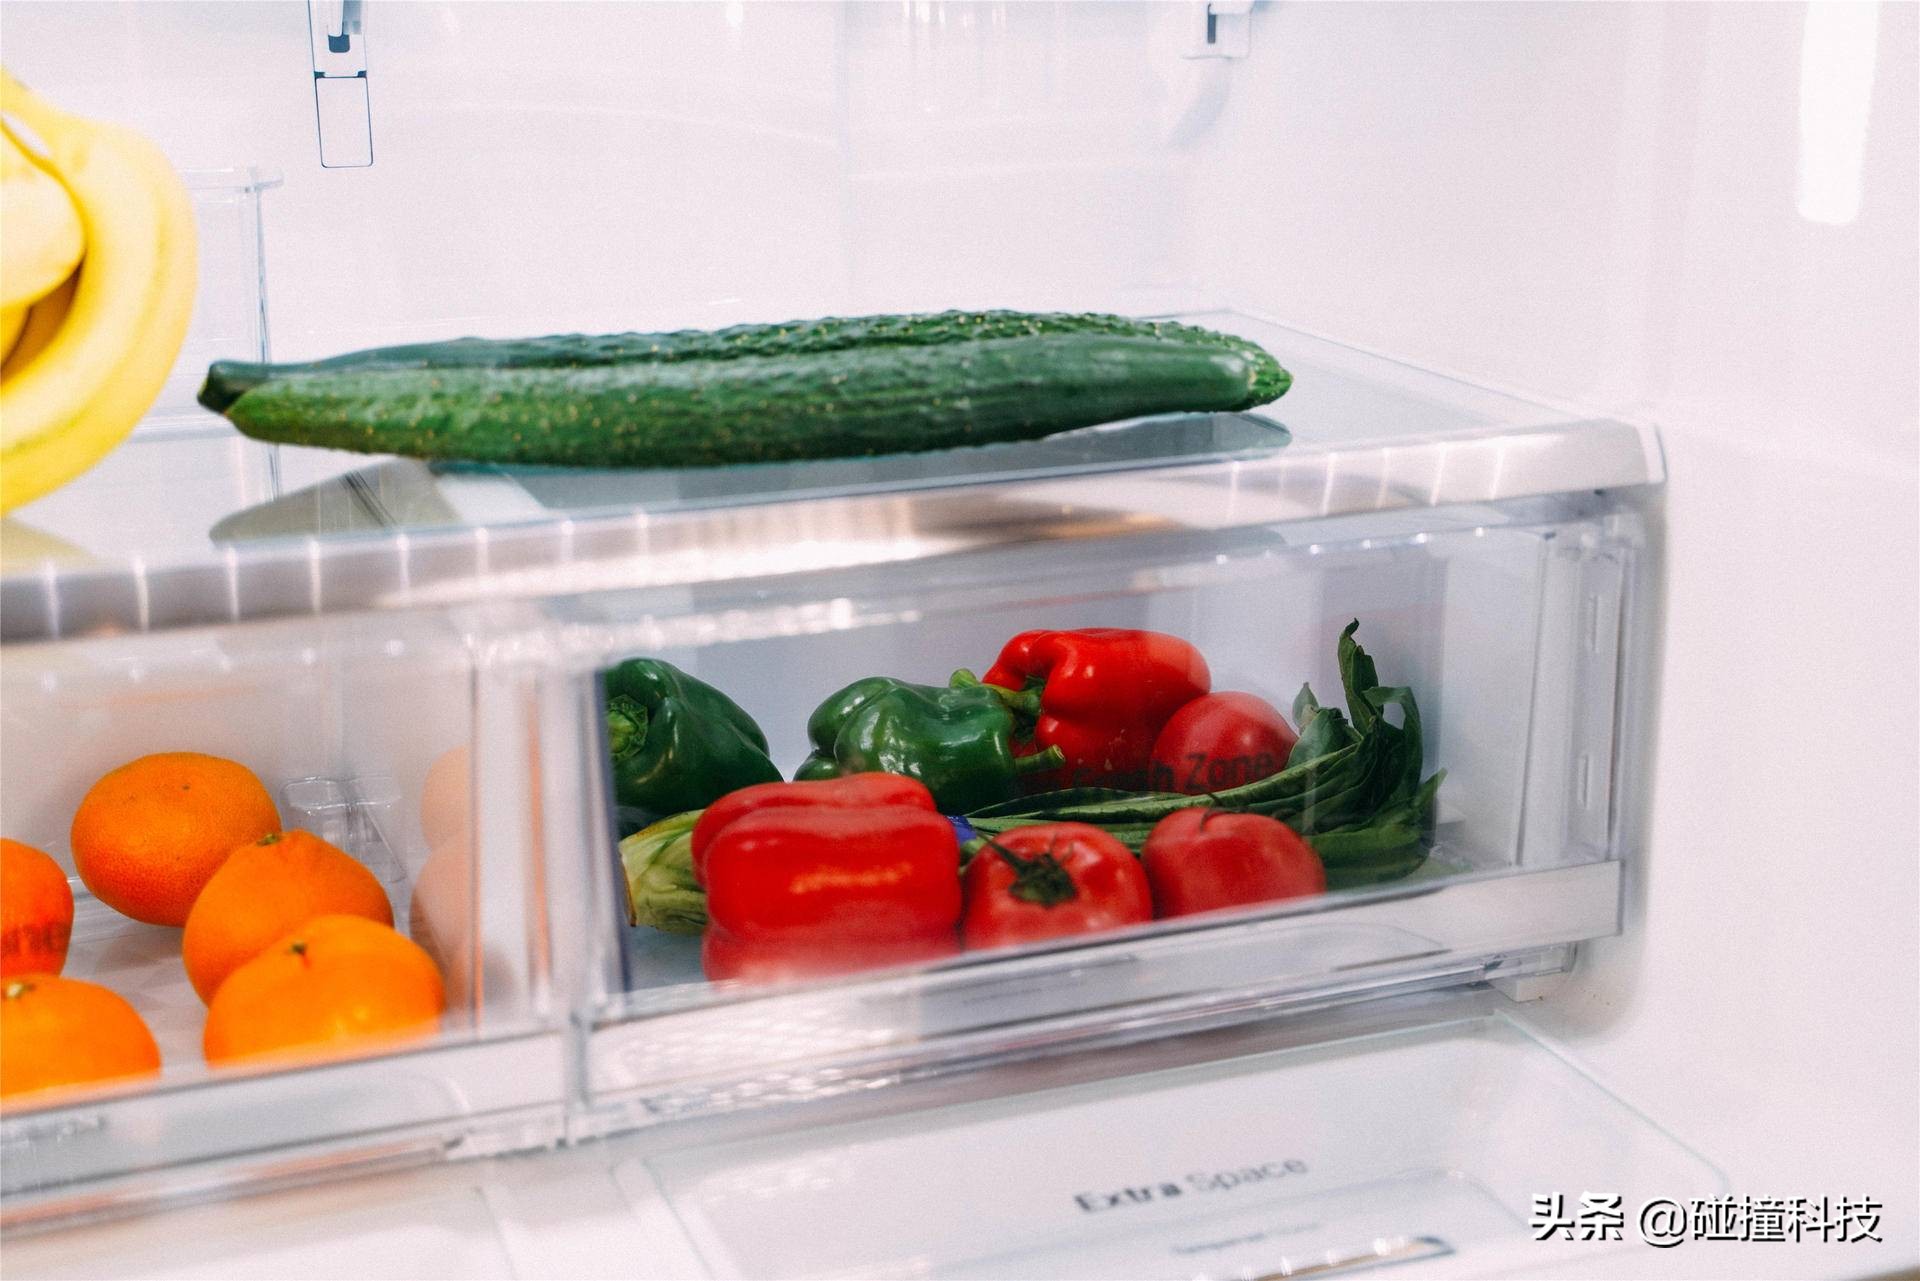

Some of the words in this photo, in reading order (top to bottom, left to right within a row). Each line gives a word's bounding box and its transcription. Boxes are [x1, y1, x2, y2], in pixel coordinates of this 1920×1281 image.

[1184, 751, 1275, 793] Zone
[1074, 1180, 1184, 1213] Extra
[1185, 1158, 1309, 1192] Space
